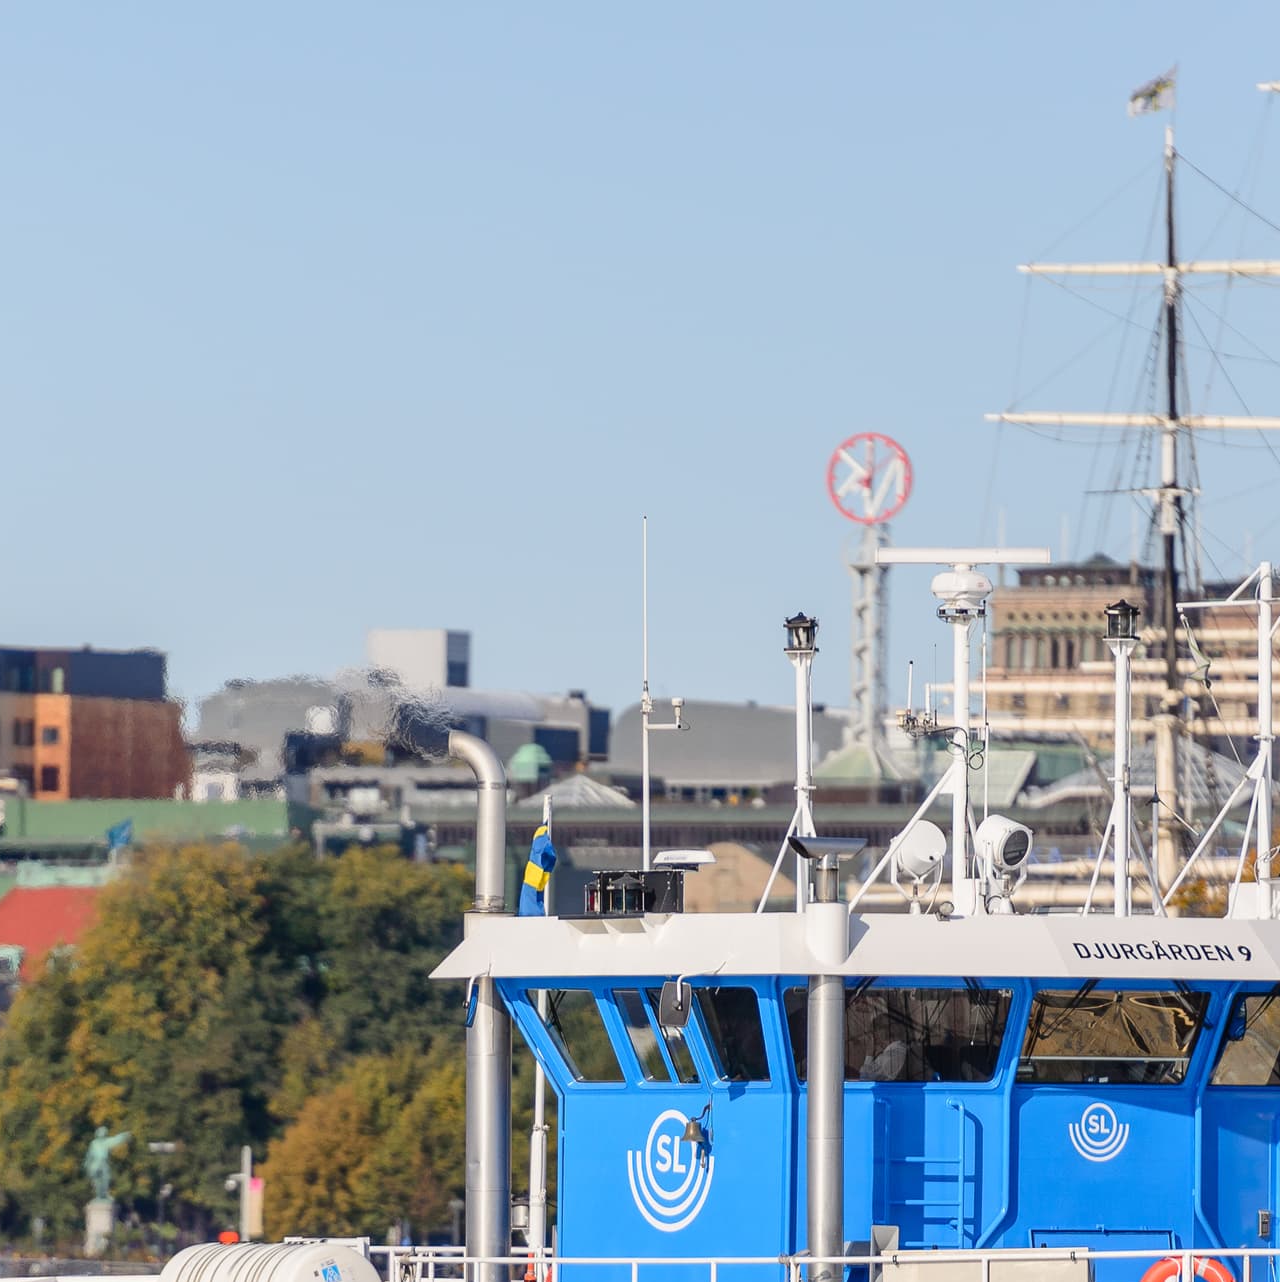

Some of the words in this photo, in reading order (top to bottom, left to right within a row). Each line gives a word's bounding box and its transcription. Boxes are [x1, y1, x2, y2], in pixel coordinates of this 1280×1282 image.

[1072, 939, 1235, 962] DJURGÅRDEN
[1237, 945, 1252, 962] 9
[1088, 1114, 1110, 1134] SL
[655, 1133, 687, 1174] SL
